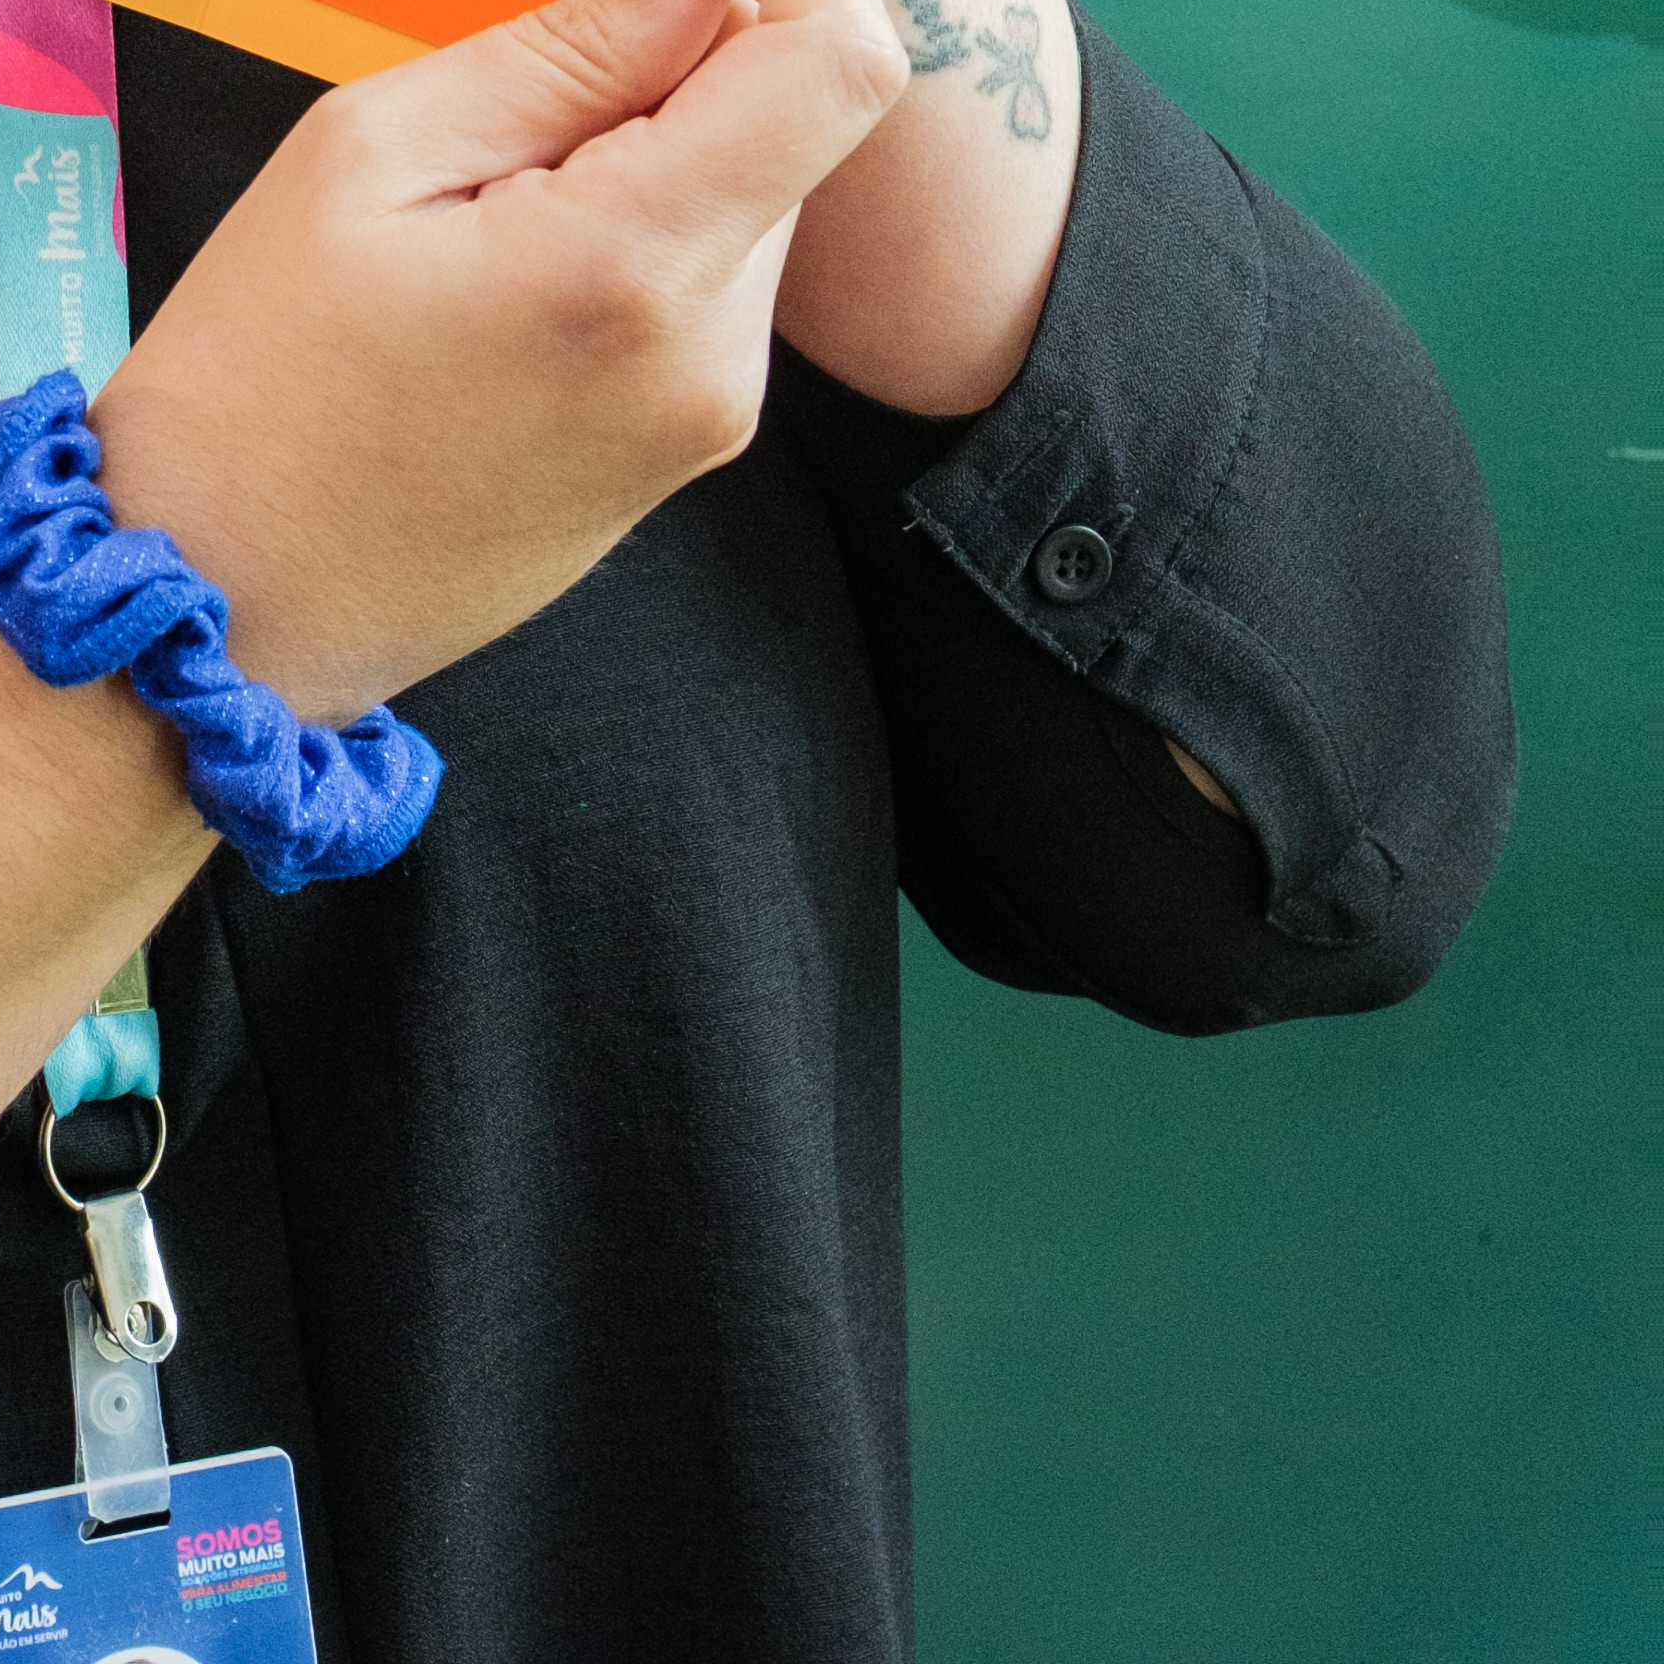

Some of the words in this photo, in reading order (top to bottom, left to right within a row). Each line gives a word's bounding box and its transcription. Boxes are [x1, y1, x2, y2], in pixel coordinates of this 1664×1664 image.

[177, 1519, 282, 1560] SOMOS
[178, 1552, 237, 1578] MUITO
[239, 1542, 285, 1566] MAIS
[182, 1600, 193, 1613] O
